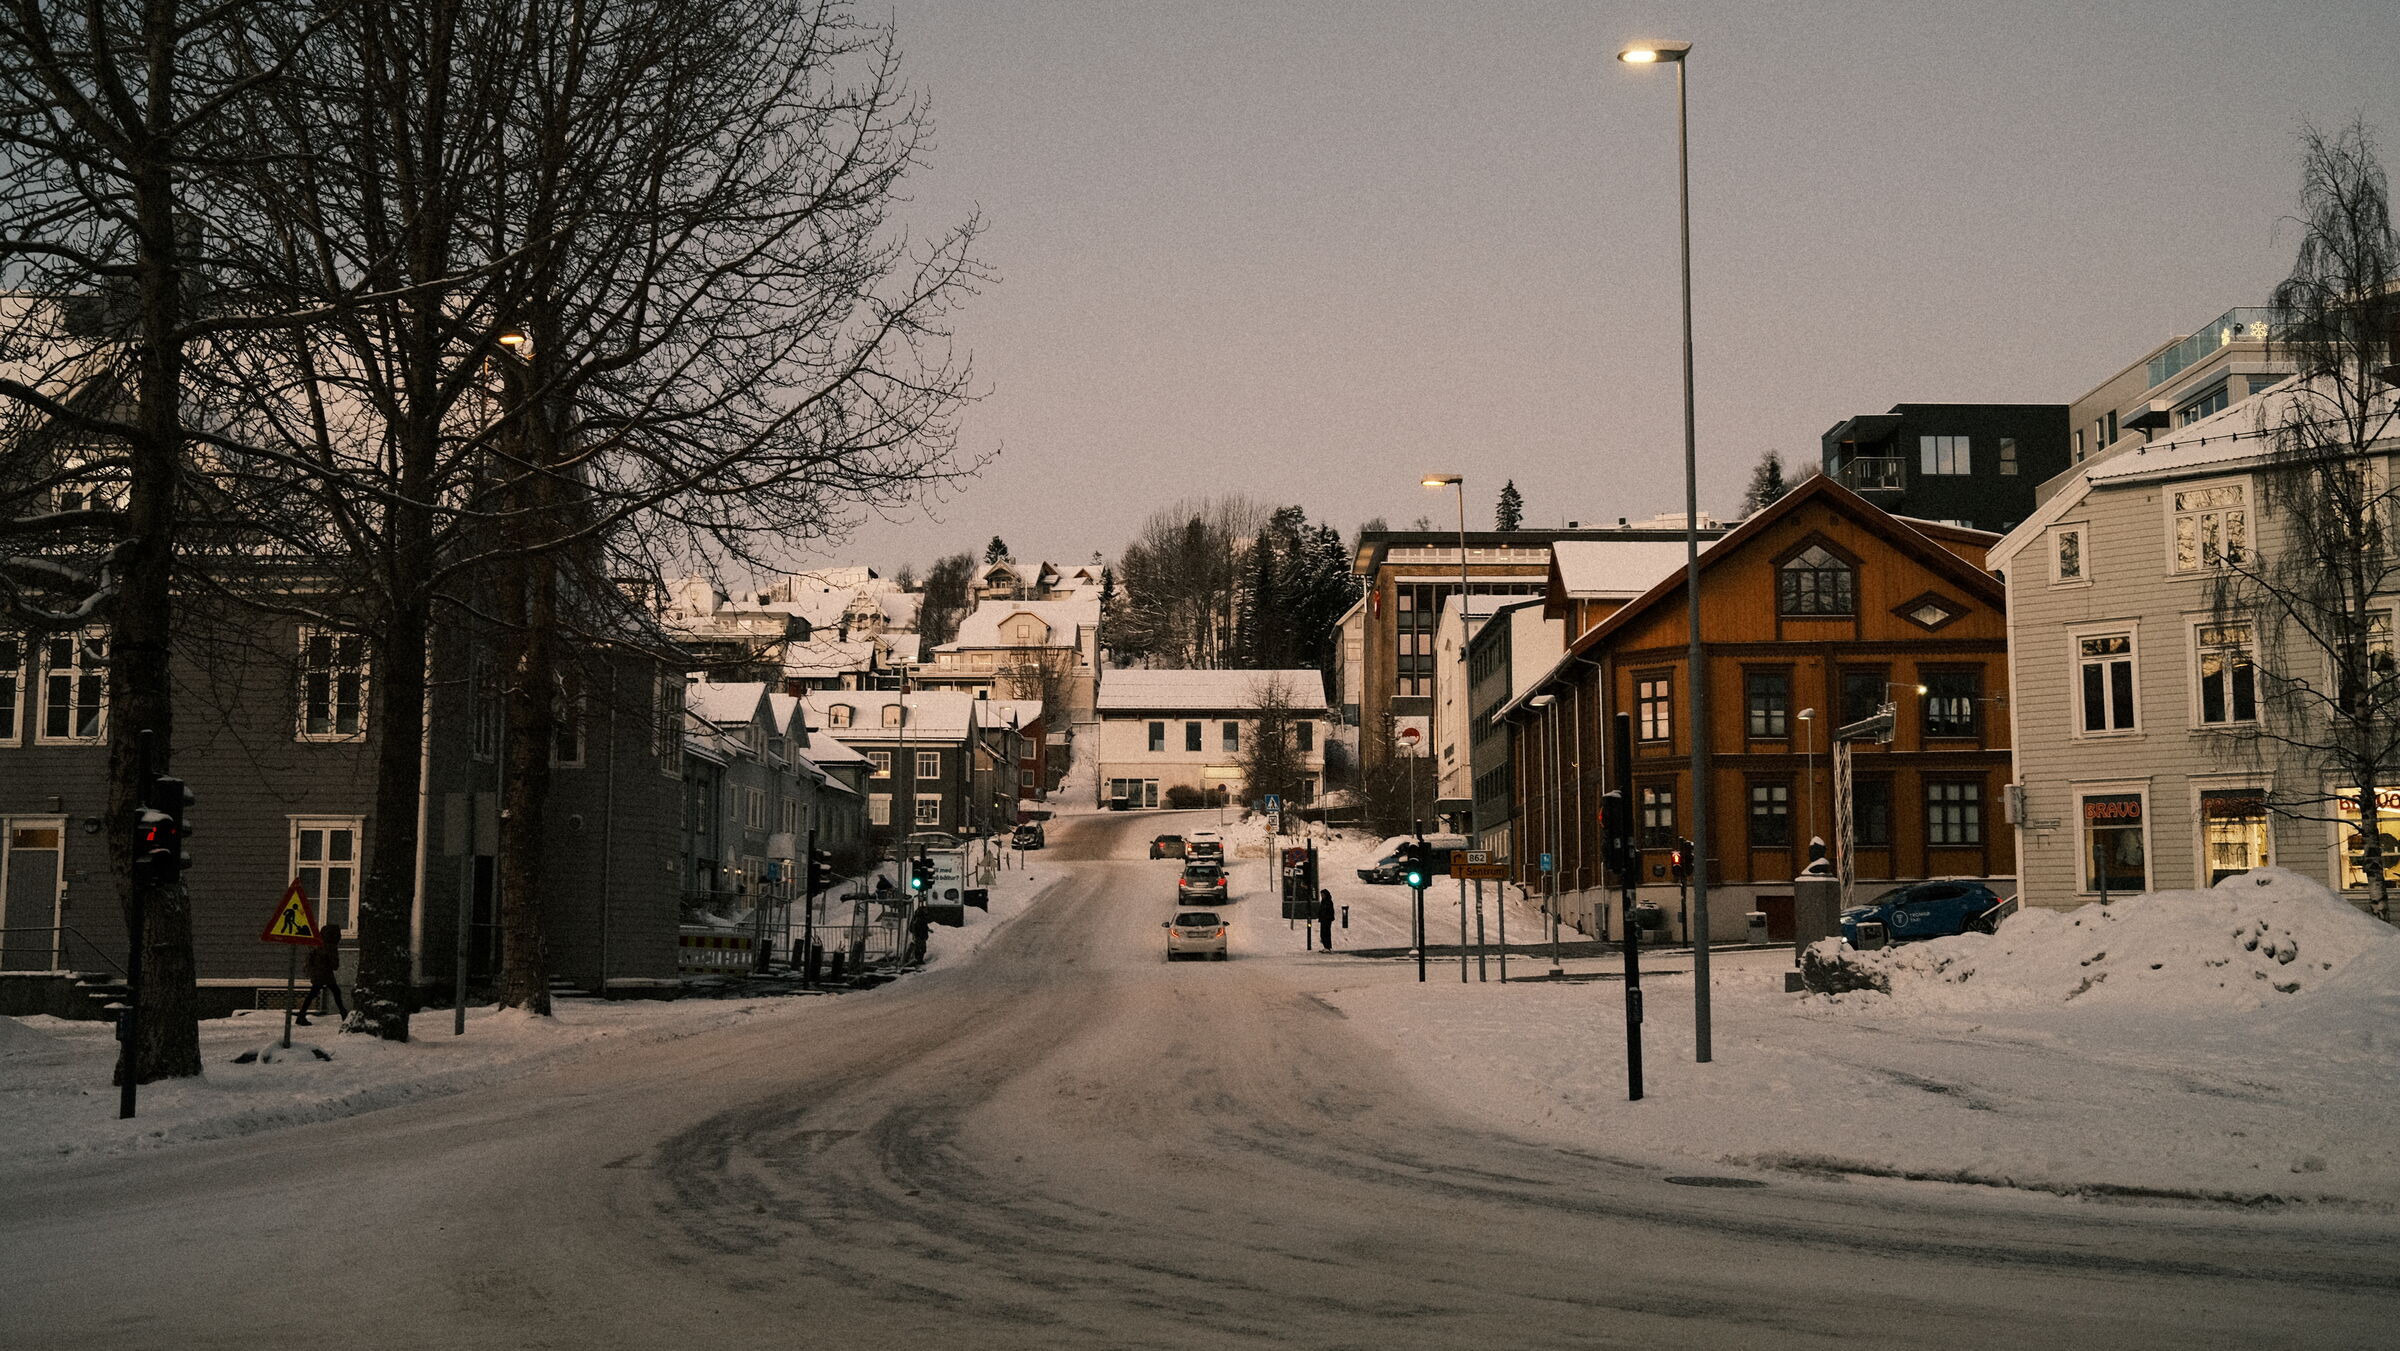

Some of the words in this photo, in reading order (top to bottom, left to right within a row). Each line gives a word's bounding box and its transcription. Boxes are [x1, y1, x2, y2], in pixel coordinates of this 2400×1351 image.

[2084, 801, 2142, 819] BRAVO
[1469, 854, 1485, 862] 862
[1466, 867, 1504, 876] Sentrum
